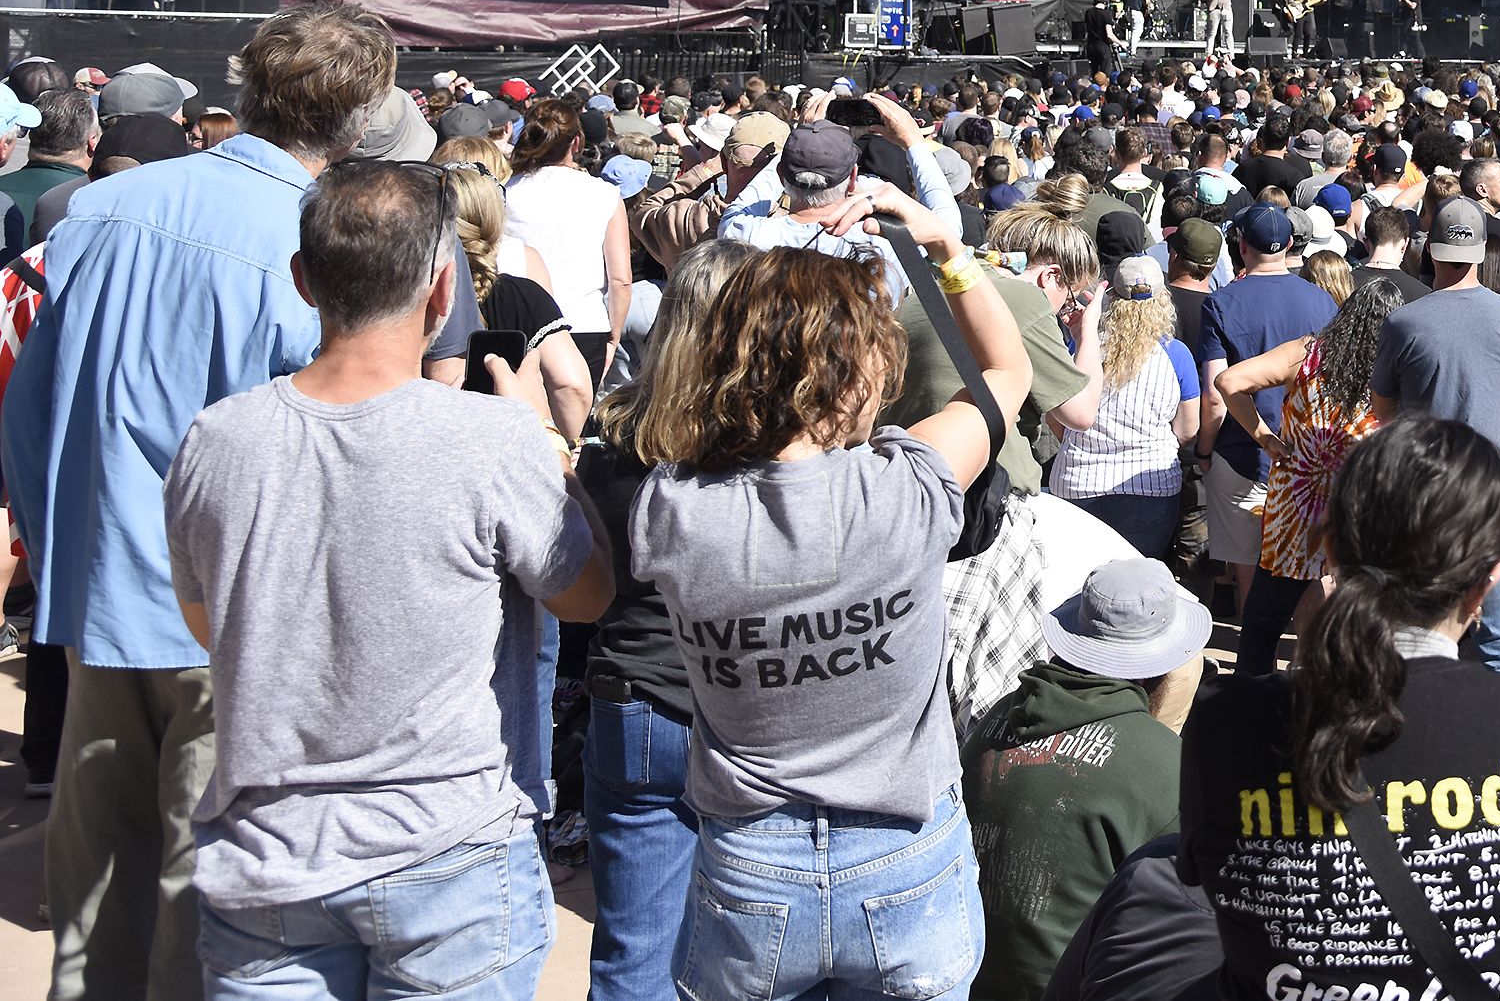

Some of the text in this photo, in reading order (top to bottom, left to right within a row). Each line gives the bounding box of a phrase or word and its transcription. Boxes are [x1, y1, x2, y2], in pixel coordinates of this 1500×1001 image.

[675, 588, 915, 651] LIVE MUSIC
[701, 630, 896, 689] IS BACK
[1055, 733, 1114, 768] DIVER
[1273, 839, 1304, 854] GUYS
[1281, 869, 1321, 889] TIME
[1286, 922, 1326, 935] TAKE
[1330, 921, 1371, 936] BACK
[1453, 915, 1483, 932] FOR
[1486, 915, 1497, 927] A
[1286, 937, 1320, 953] GOOD
[1321, 938, 1399, 952] RIDDANCE
[1324, 953, 1414, 966] PROSTHETIC
